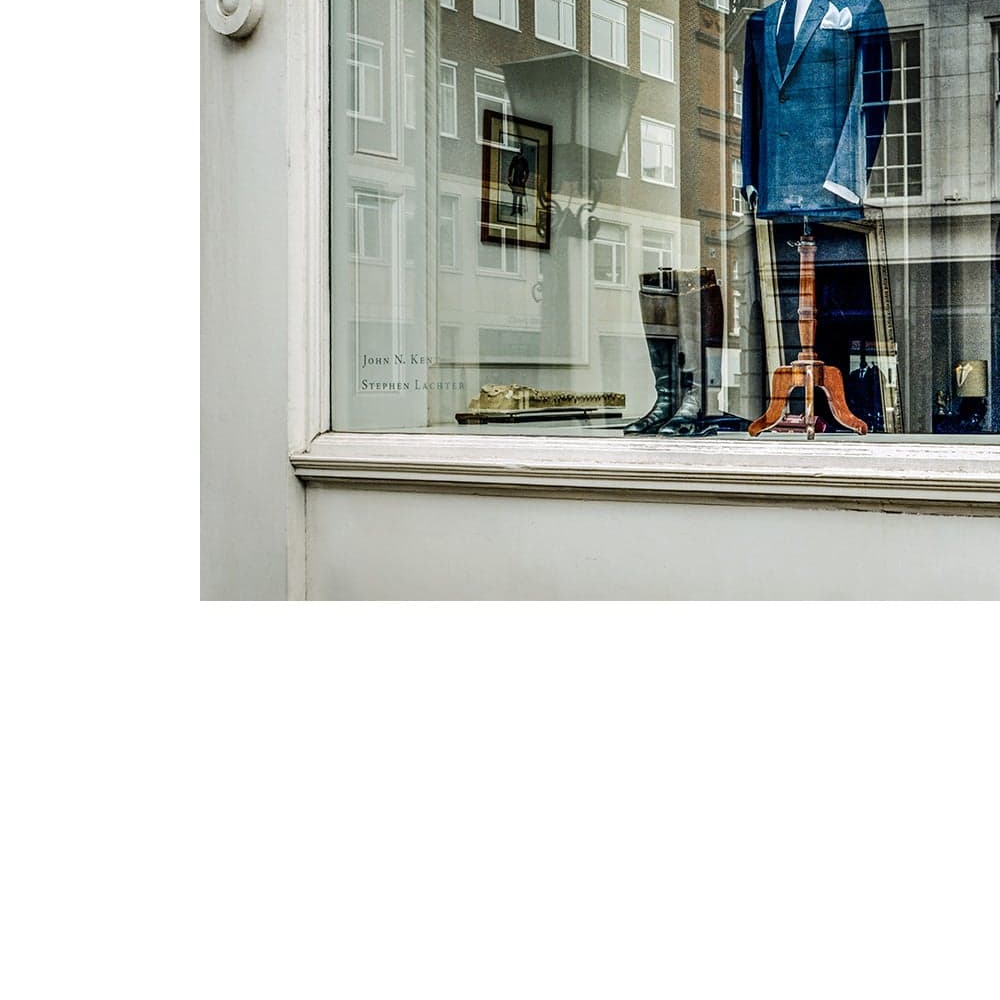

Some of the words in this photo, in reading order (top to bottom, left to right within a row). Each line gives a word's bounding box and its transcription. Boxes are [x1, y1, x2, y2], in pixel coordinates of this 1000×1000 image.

[362, 354, 390, 368] JOHN
[394, 354, 406, 365] N.
[411, 354, 438, 365] KEN
[361, 379, 410, 390] STEPHEN
[415, 379, 465, 390] LACHTER
